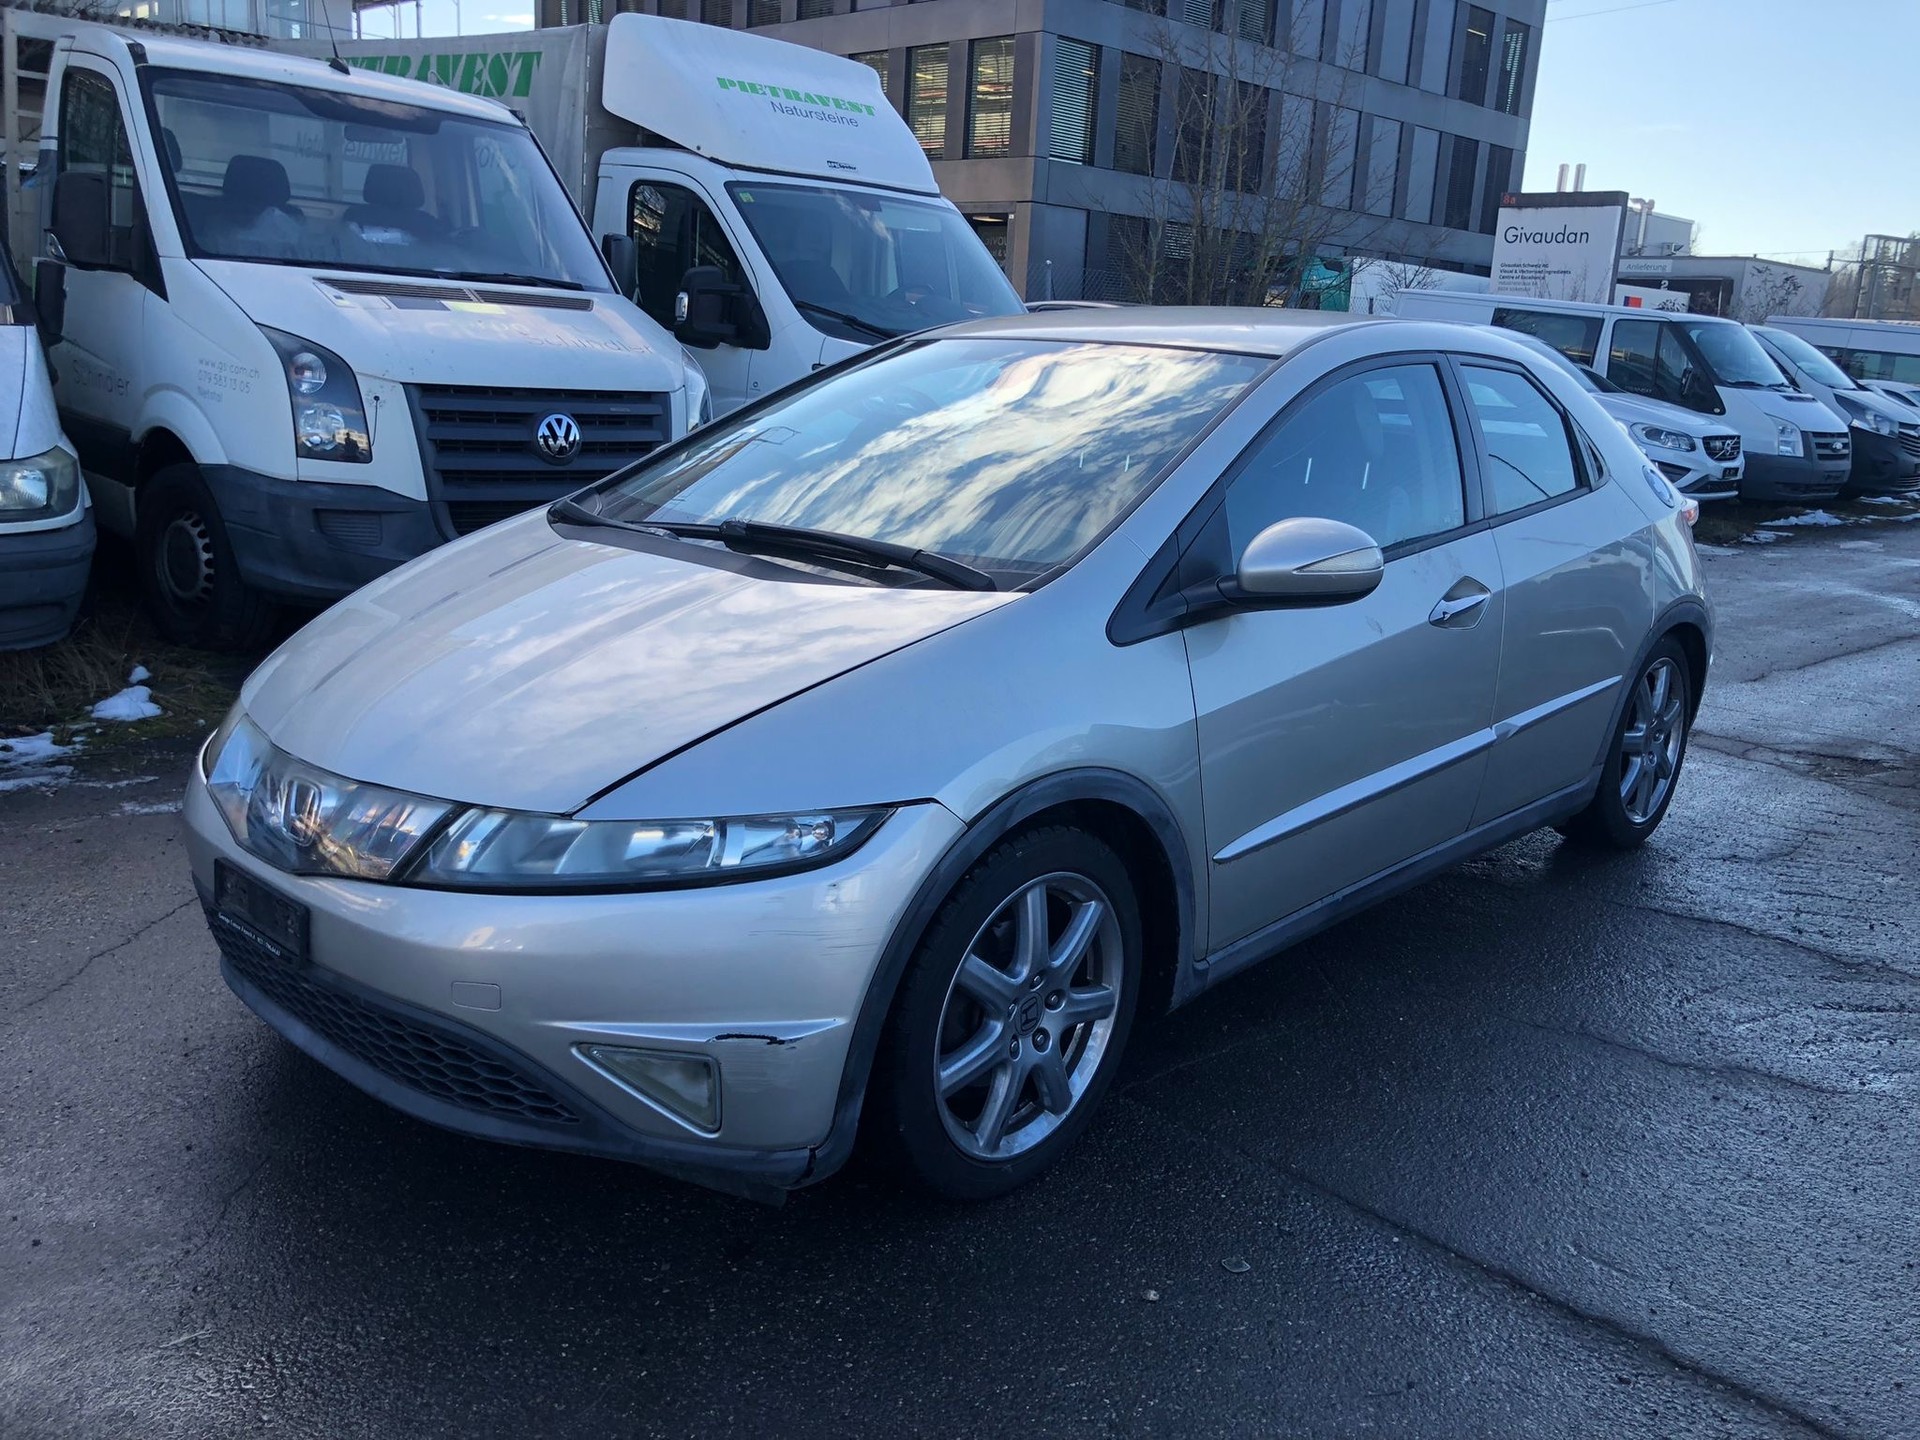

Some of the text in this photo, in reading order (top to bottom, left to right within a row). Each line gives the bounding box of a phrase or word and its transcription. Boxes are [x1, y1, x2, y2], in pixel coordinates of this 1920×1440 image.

[716, 76, 876, 117] PIETRAVEST
[770, 101, 859, 128] Natursteine
[1504, 224, 1590, 244] Givaudan
[1625, 262, 1668, 271] Anlieferung
[1660, 280, 1669, 290] 2
